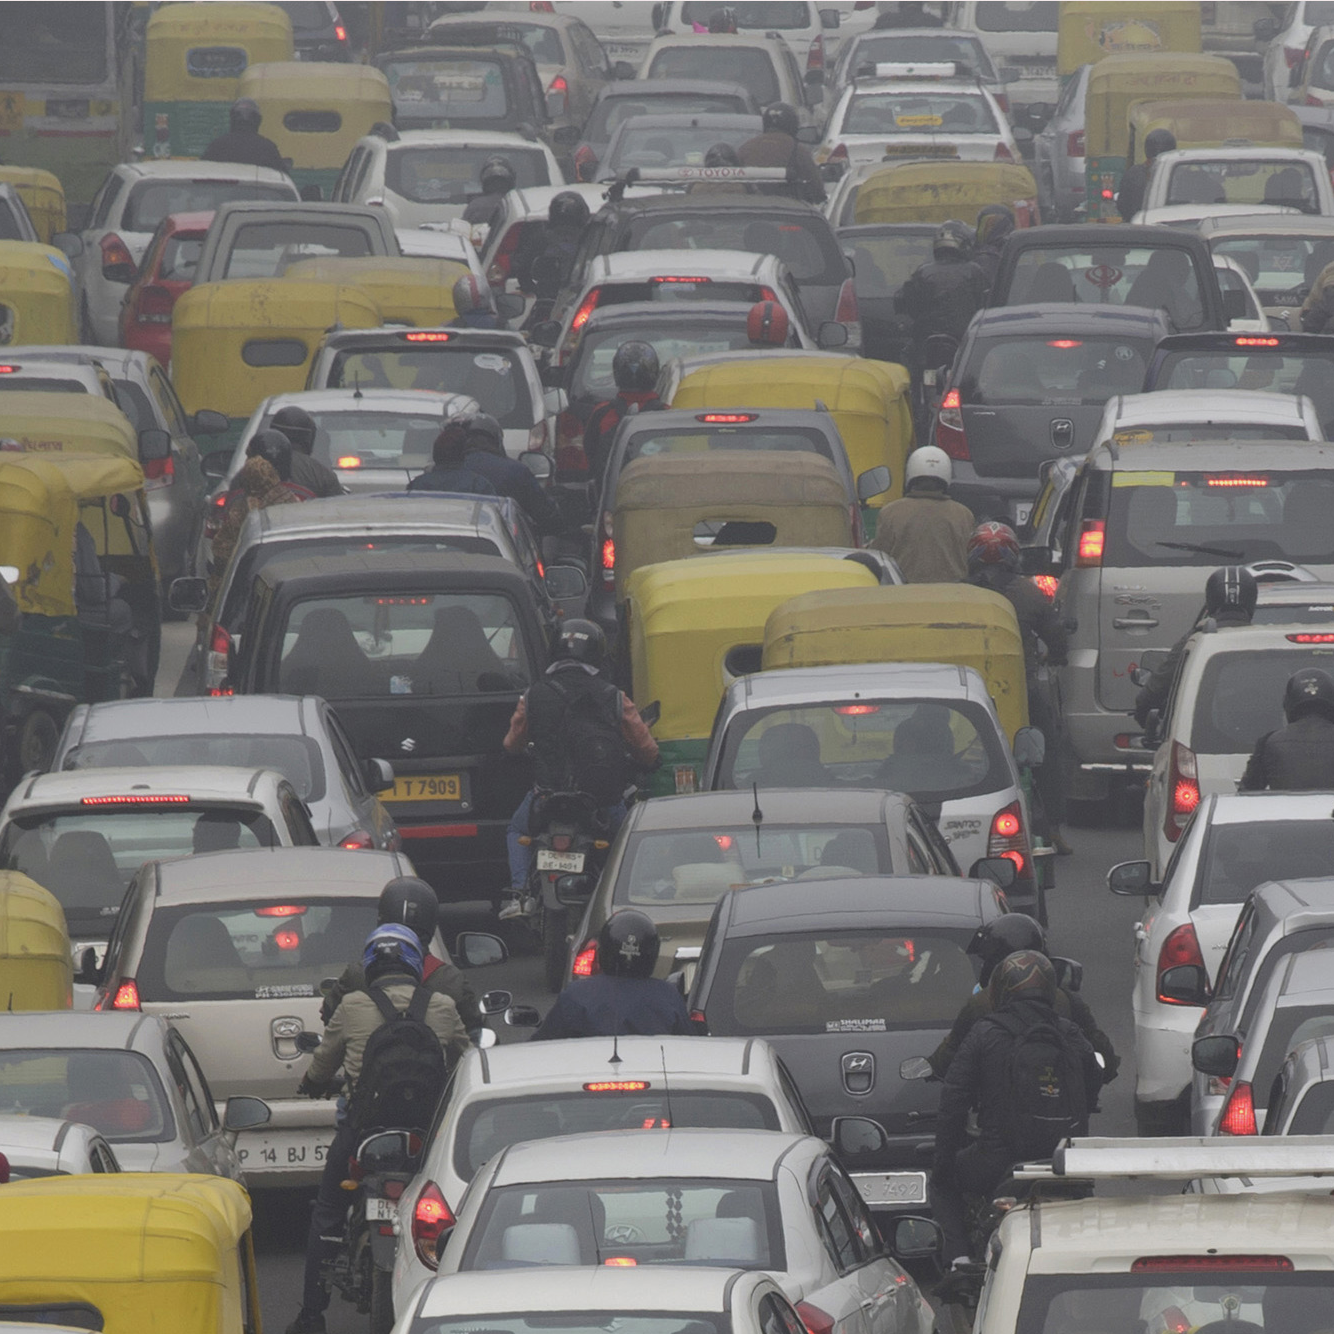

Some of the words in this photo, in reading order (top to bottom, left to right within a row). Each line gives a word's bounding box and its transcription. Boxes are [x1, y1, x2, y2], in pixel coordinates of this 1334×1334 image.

[698, 167, 746, 177] TOYOTA
[404, 781, 414, 796] T
[418, 780, 457, 795] 7909
[261, 1148, 276, 1162] 14
[287, 1147, 306, 1161] BJ
[883, 1182, 919, 1197] 7492
